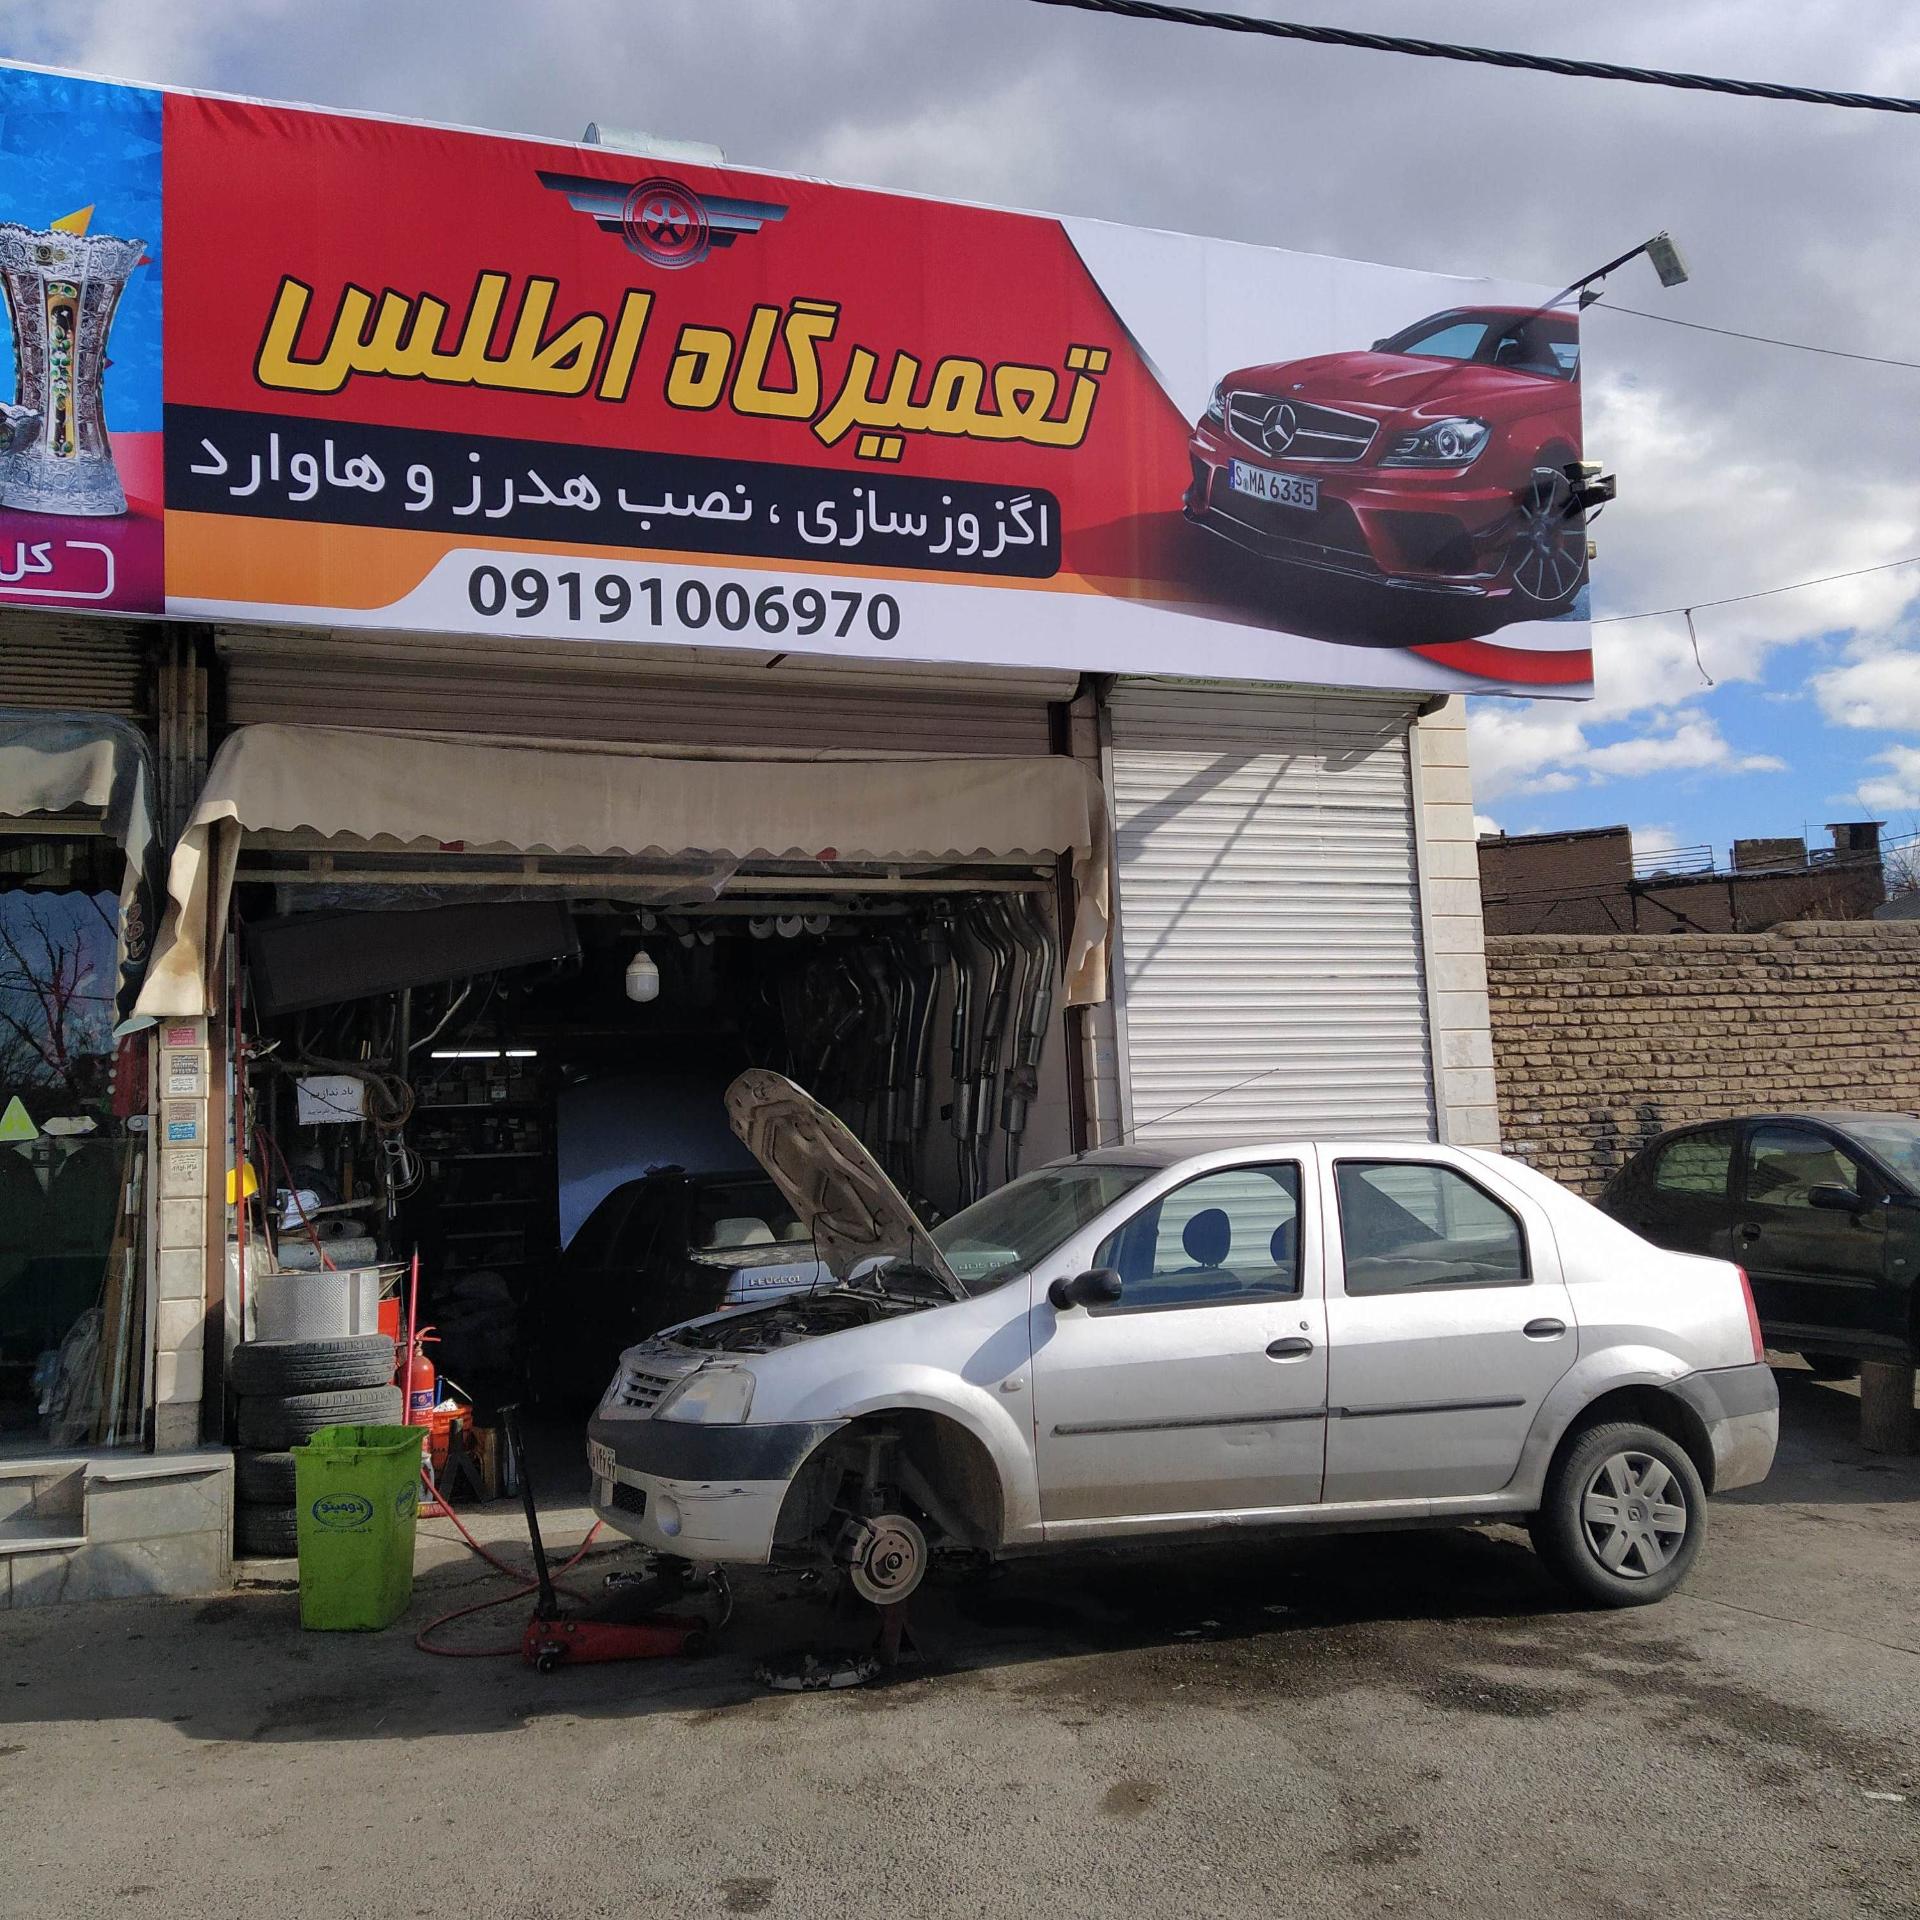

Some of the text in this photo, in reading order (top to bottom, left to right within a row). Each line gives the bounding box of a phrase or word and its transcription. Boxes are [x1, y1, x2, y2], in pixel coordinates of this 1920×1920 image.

[254, 270, 1110, 462] تعمیرگاه اطلس
[190, 432, 386, 502] هاوارد
[404, 463, 434, 512] و
[453, 452, 602, 518] هدرز
[1249, 469, 1266, 496] MA
[1270, 476, 1314, 506] 6335
[617, 484, 753, 531] نصب
[468, 566, 901, 641] 09191006970
[749, 1275, 800, 1287] PEUGEOT
